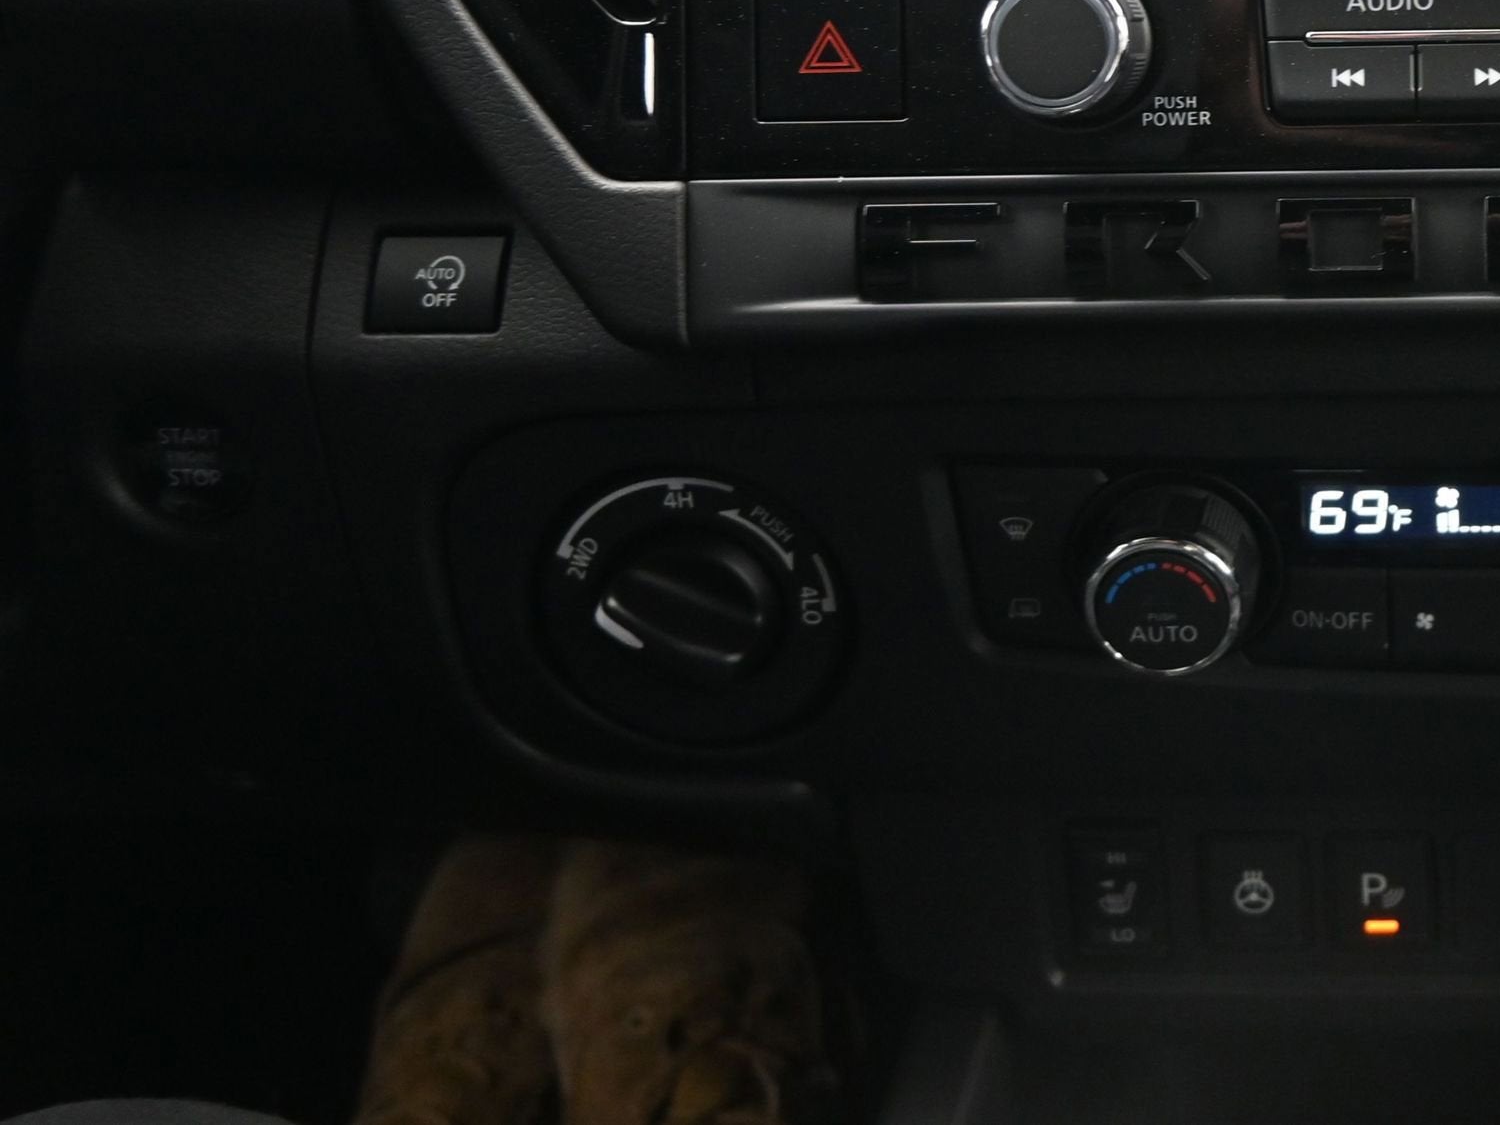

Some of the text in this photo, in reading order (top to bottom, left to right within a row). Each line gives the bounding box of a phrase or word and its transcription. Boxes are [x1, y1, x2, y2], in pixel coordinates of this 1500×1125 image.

[1154, 95, 1197, 109] PUSH
[1142, 111, 1212, 127] POWER
[415, 267, 455, 281] AUTO
[421, 292, 457, 308] OFF
[158, 427, 220, 445] START
[167, 467, 221, 487] STOP
[663, 491, 694, 509] 4H
[749, 505, 793, 543] PUSH
[566, 537, 599, 580] 2WD
[800, 586, 823, 625] 4LO
[1292, 610, 1373, 630] ON-OFF
[1129, 625, 1199, 643] AUTO
[1361, 873, 1387, 906] P
[1110, 928, 1136, 942] LO
